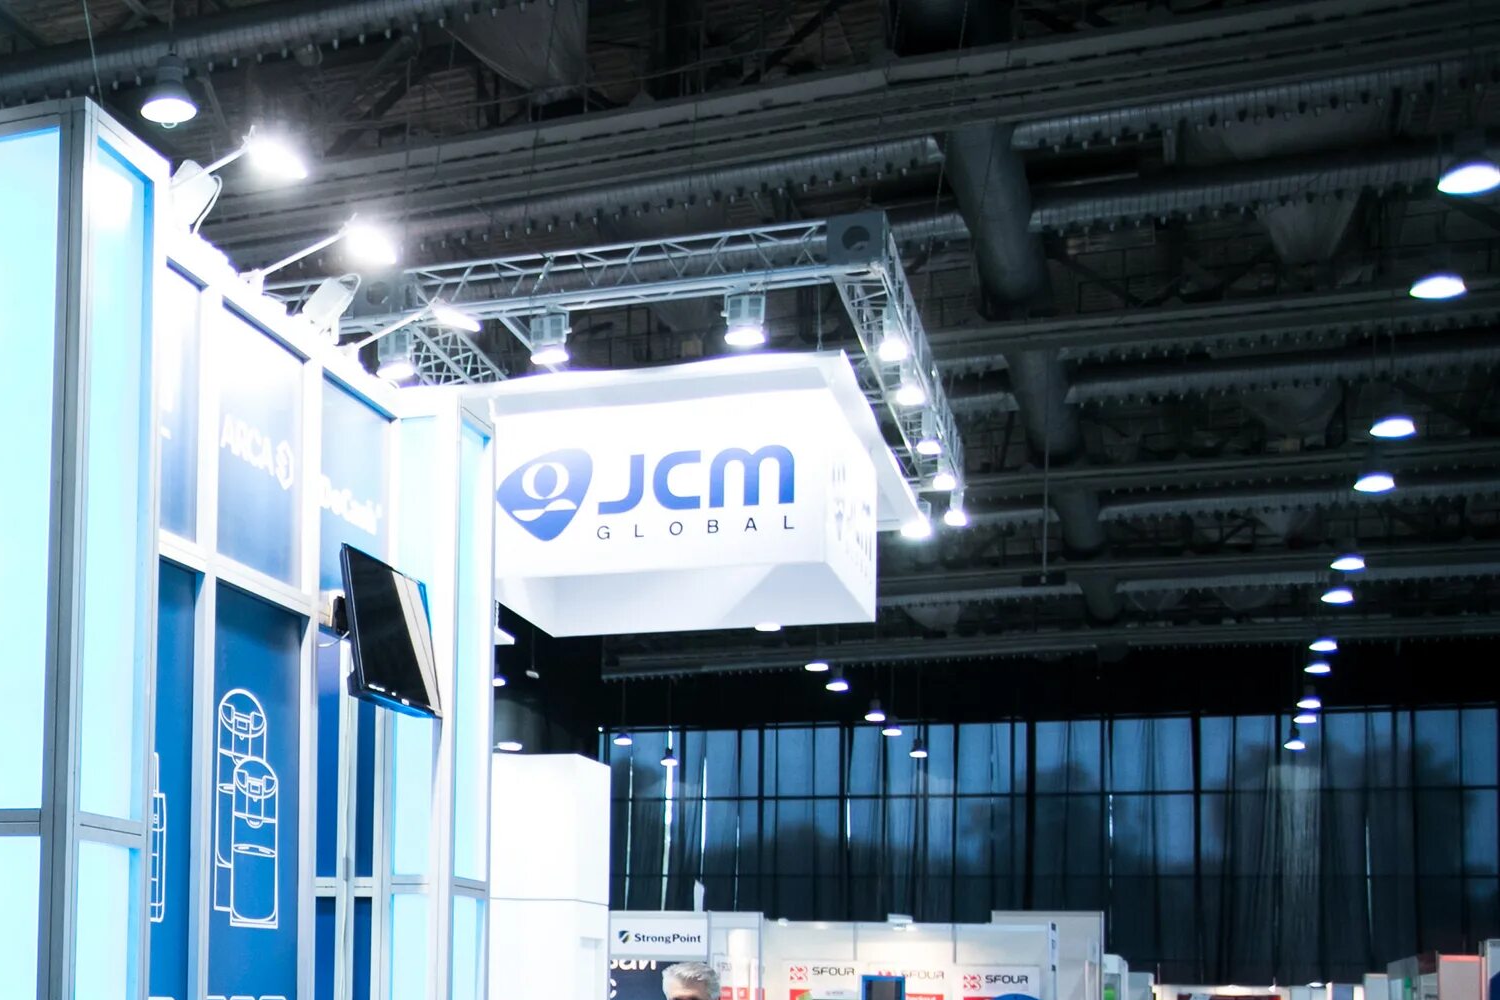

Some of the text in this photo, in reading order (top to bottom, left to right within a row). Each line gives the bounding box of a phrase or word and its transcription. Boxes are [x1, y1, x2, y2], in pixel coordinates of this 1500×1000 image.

[220, 414, 275, 477] ARCA
[597, 515, 795, 540] GLOBAL
[812, 966, 855, 977] SFOUR
[985, 974, 1029, 985] SFOUR
